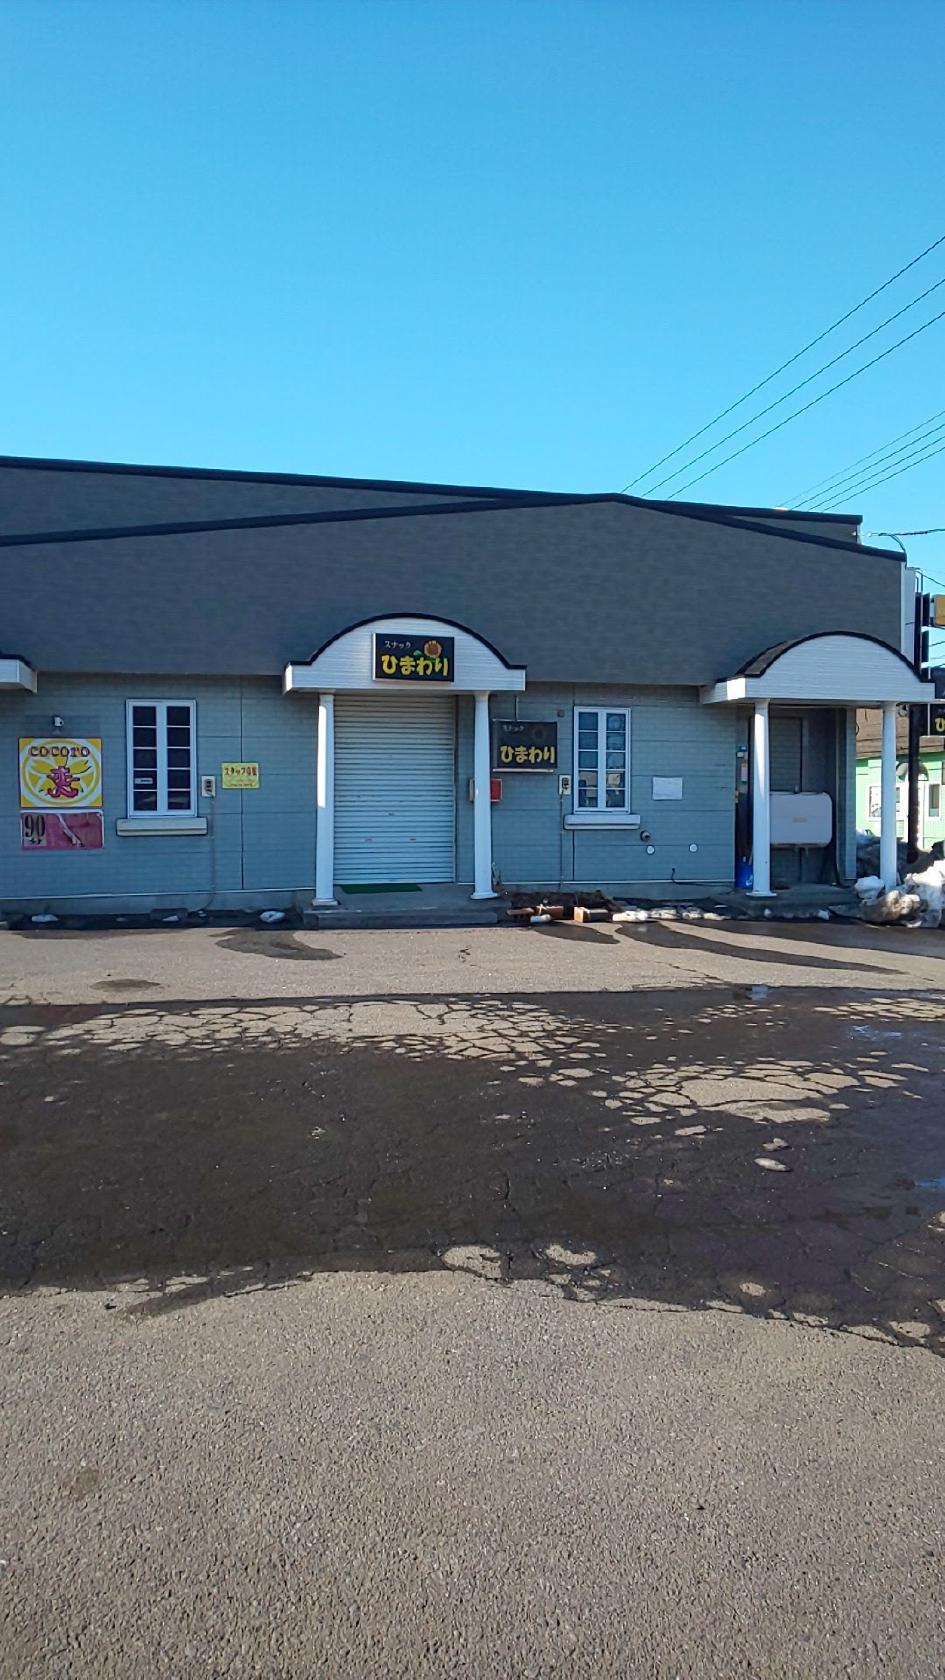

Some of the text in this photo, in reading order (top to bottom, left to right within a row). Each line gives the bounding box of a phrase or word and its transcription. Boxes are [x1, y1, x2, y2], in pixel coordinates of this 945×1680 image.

[384, 640, 412, 649] スナック
[381, 655, 449, 676] ひまわり
[500, 745, 555, 764] ひまわり
